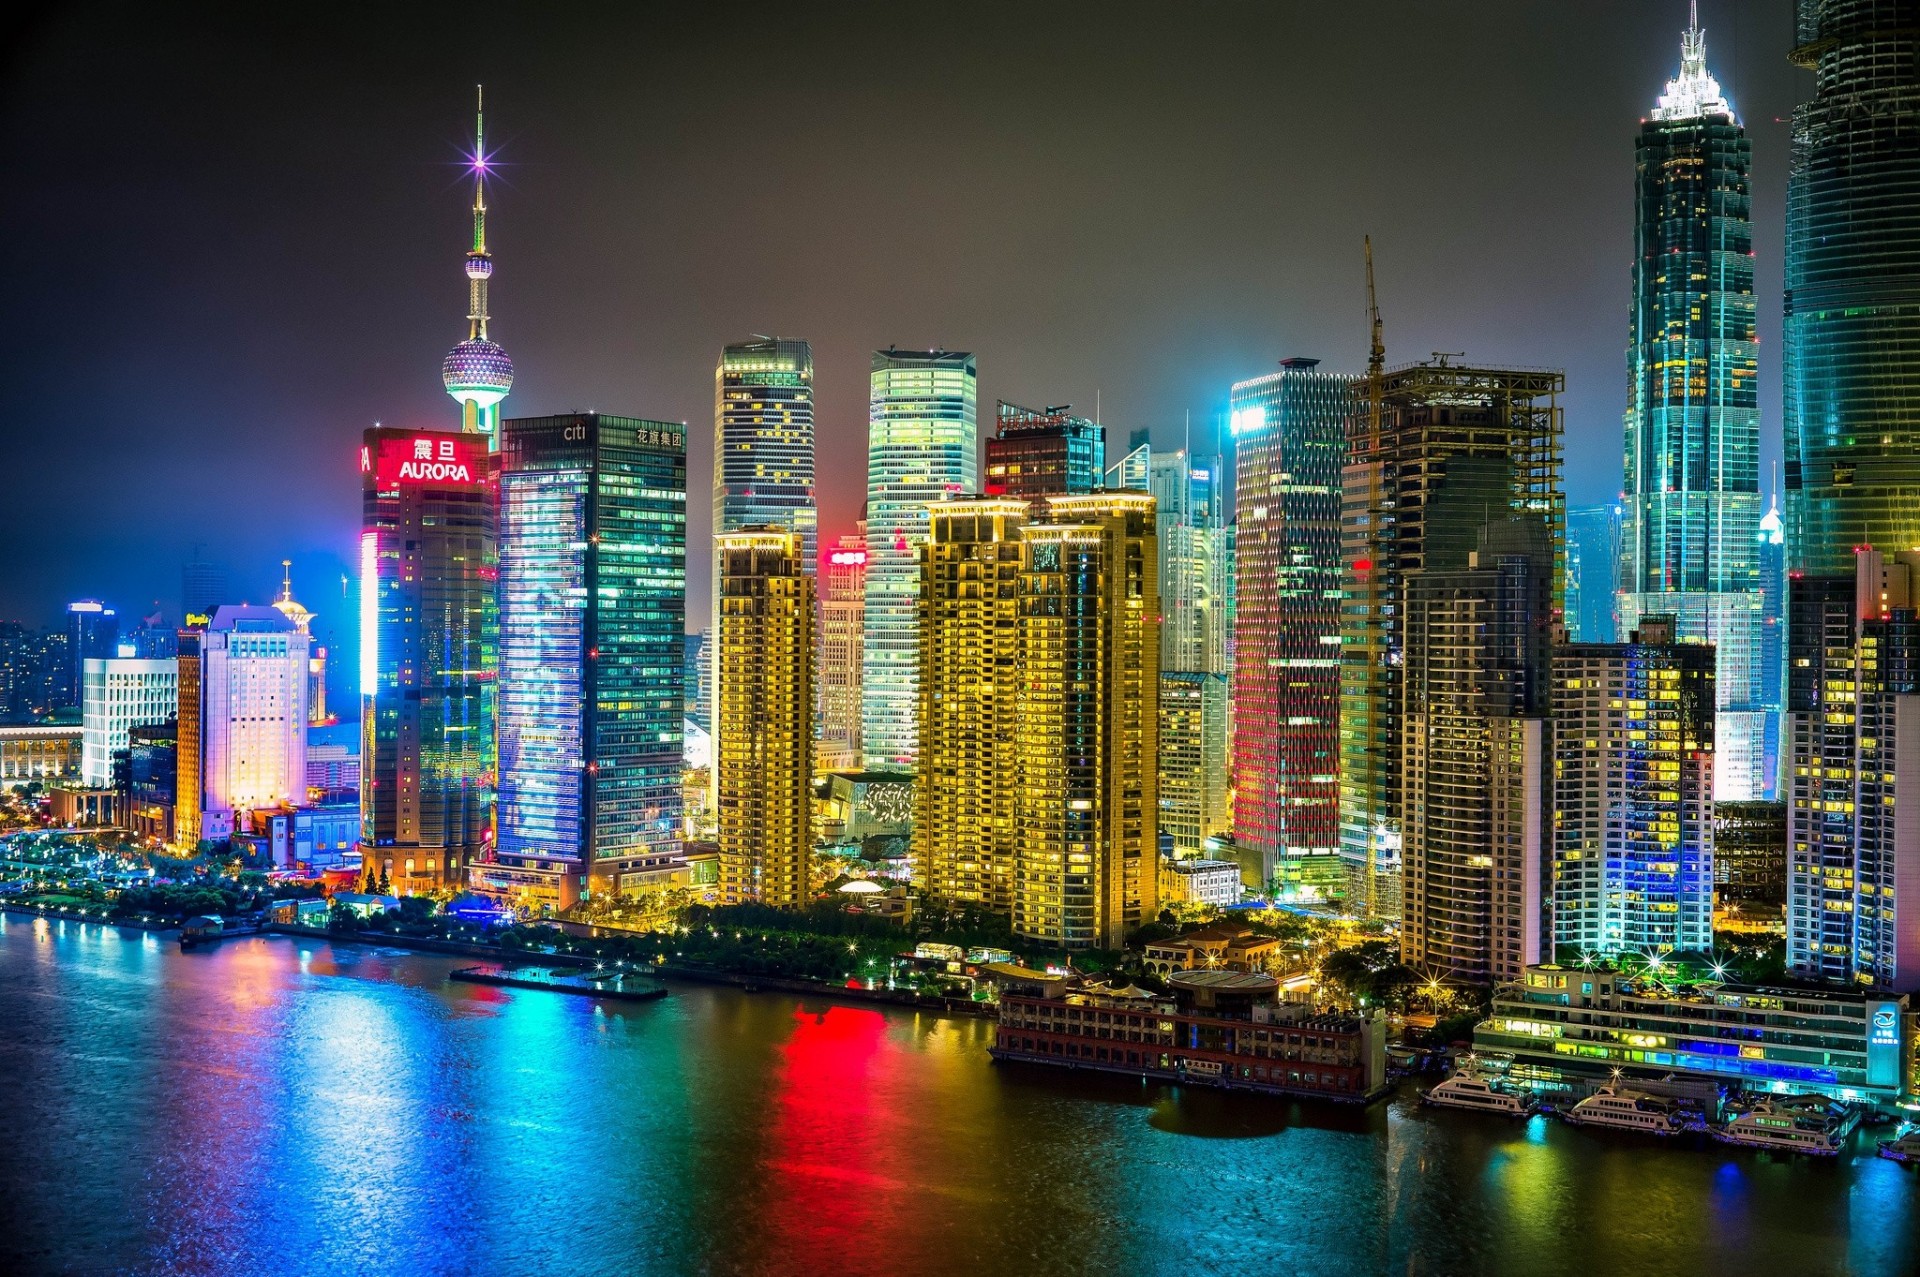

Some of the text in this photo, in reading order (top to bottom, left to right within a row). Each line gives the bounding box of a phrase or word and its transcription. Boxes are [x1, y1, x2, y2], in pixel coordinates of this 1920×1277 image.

[564, 424, 586, 441] citi
[637, 428, 682, 447] 花旗集团
[414, 439, 456, 461] 震旦
[399, 461, 470, 481] AURORA
